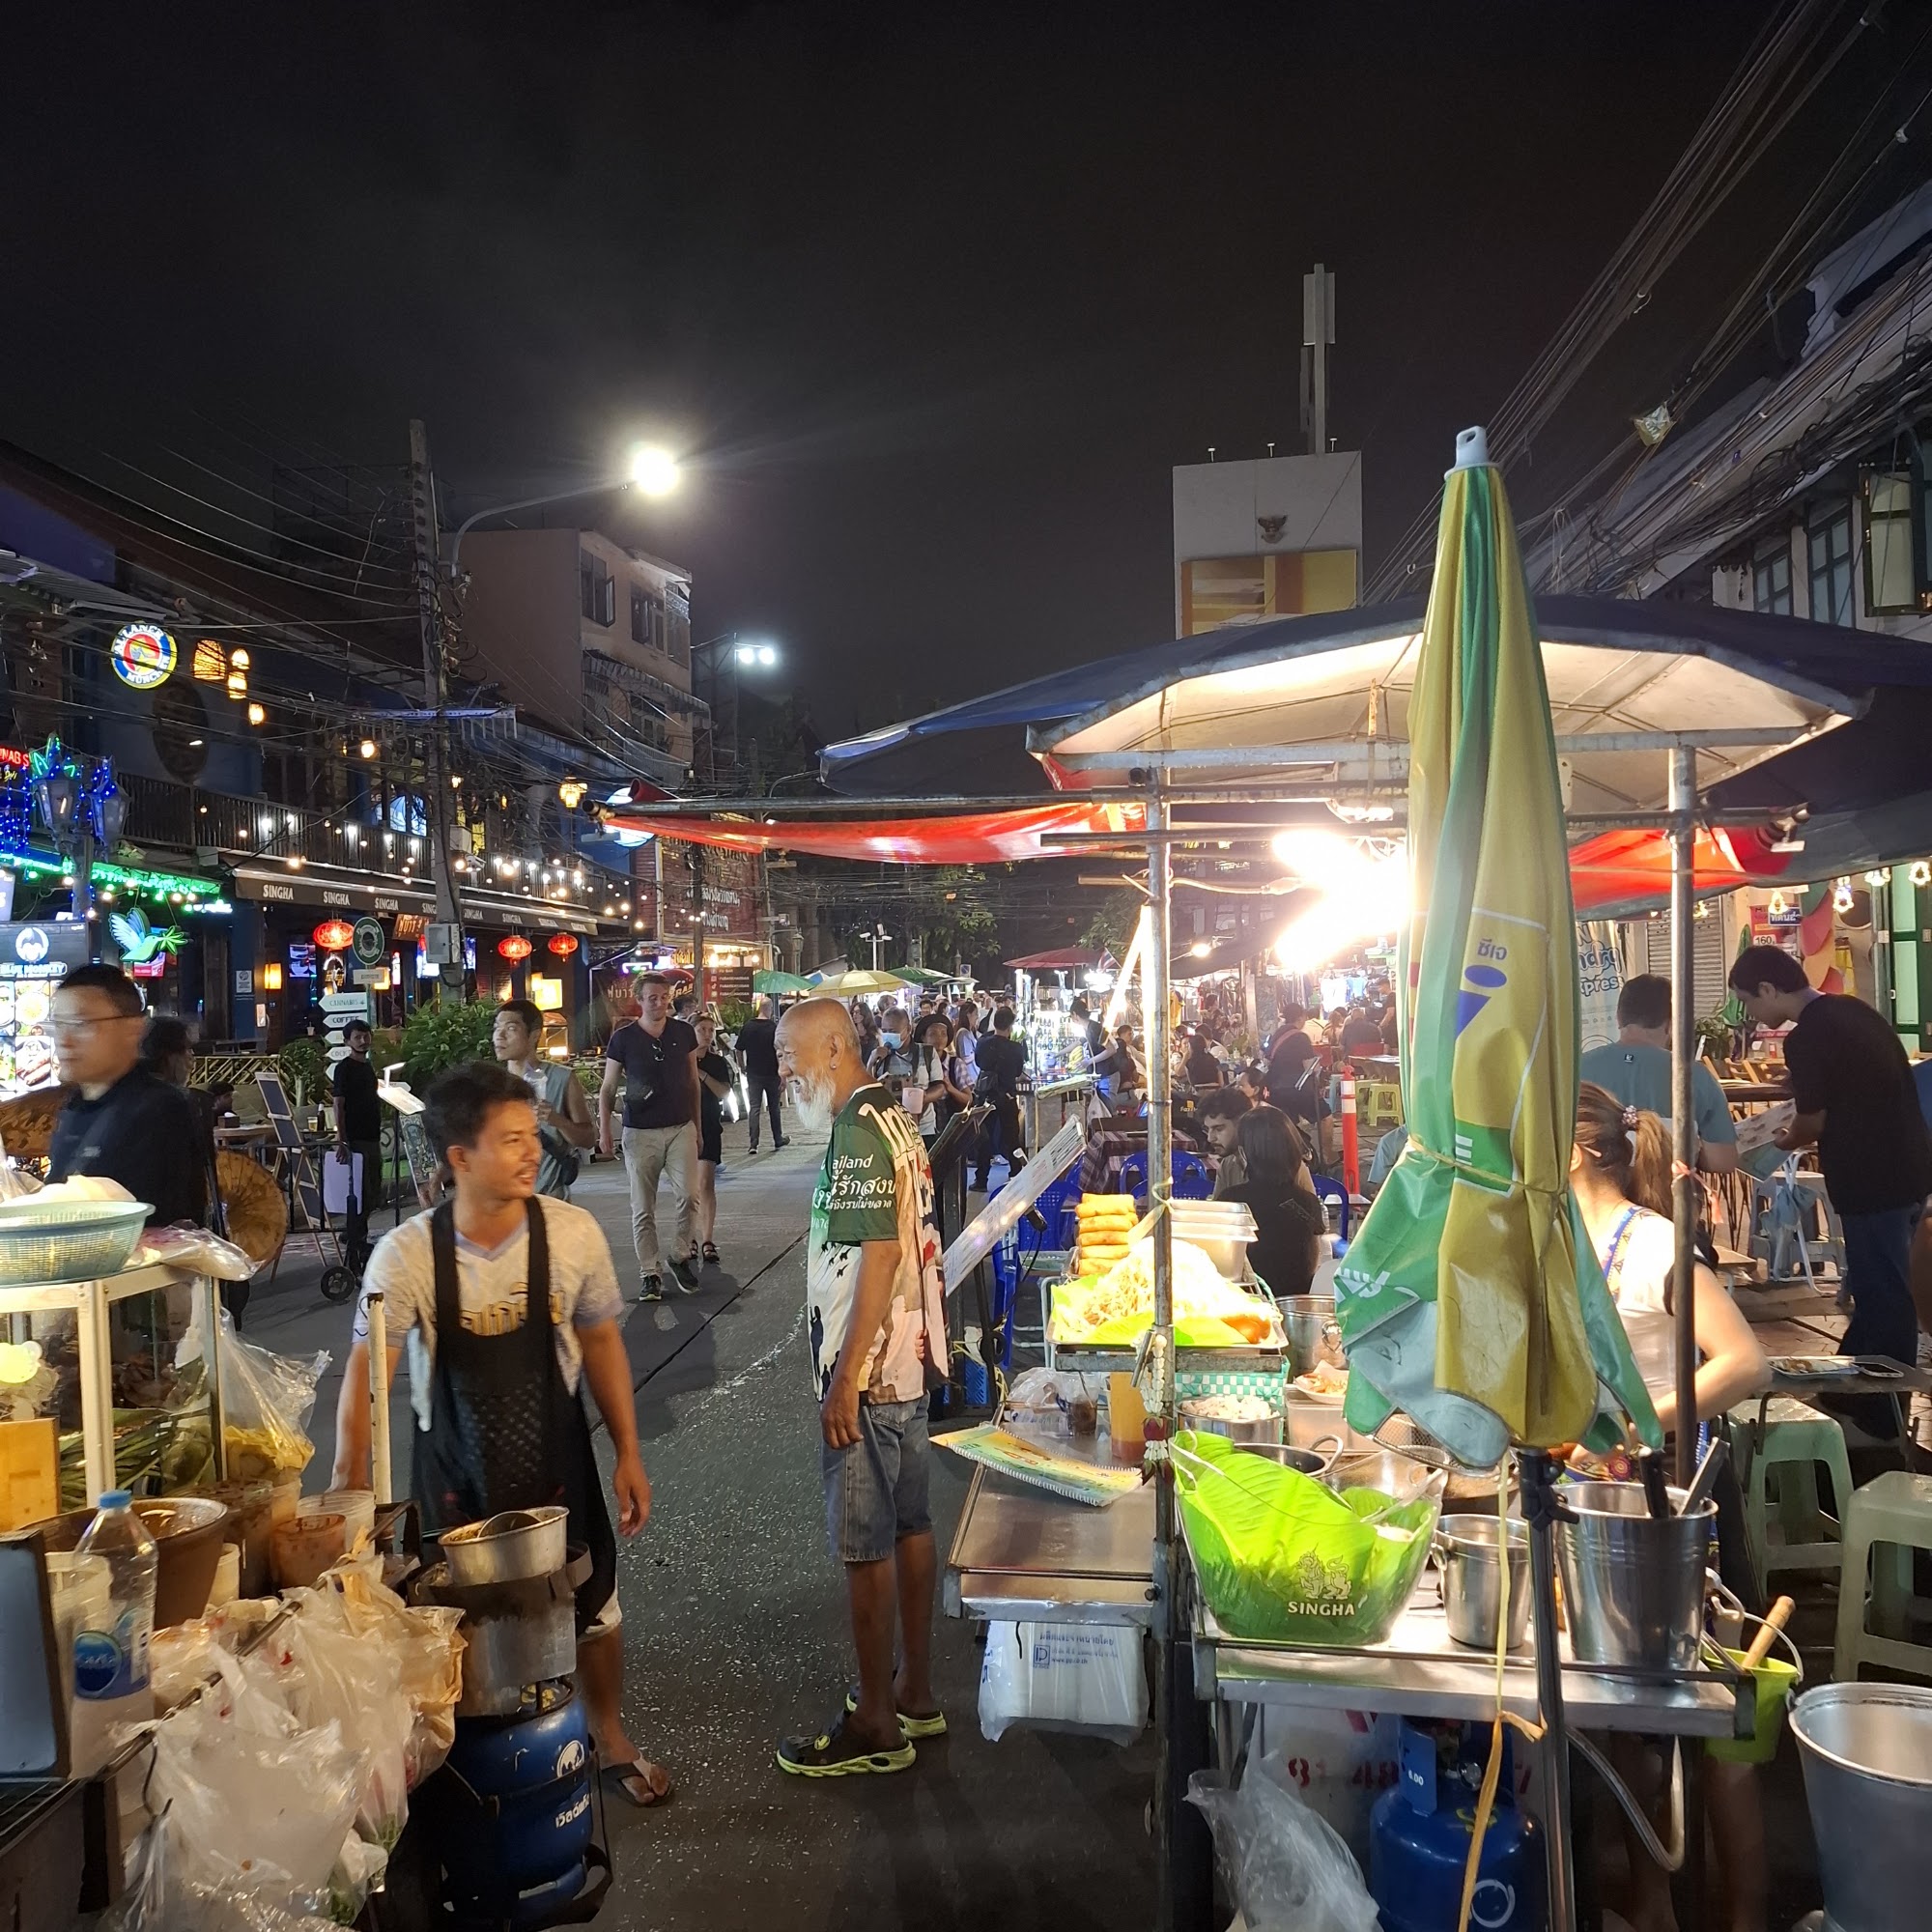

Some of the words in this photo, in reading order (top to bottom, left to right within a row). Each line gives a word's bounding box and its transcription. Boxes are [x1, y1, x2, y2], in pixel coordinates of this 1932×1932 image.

[263, 884, 294, 900] SINGHA
[323, 891, 351, 906] SINGHA
[374, 897, 399, 911] SINGHA
[421, 902, 437, 915] SING
[1288, 1601, 1355, 1616] SINGHA
